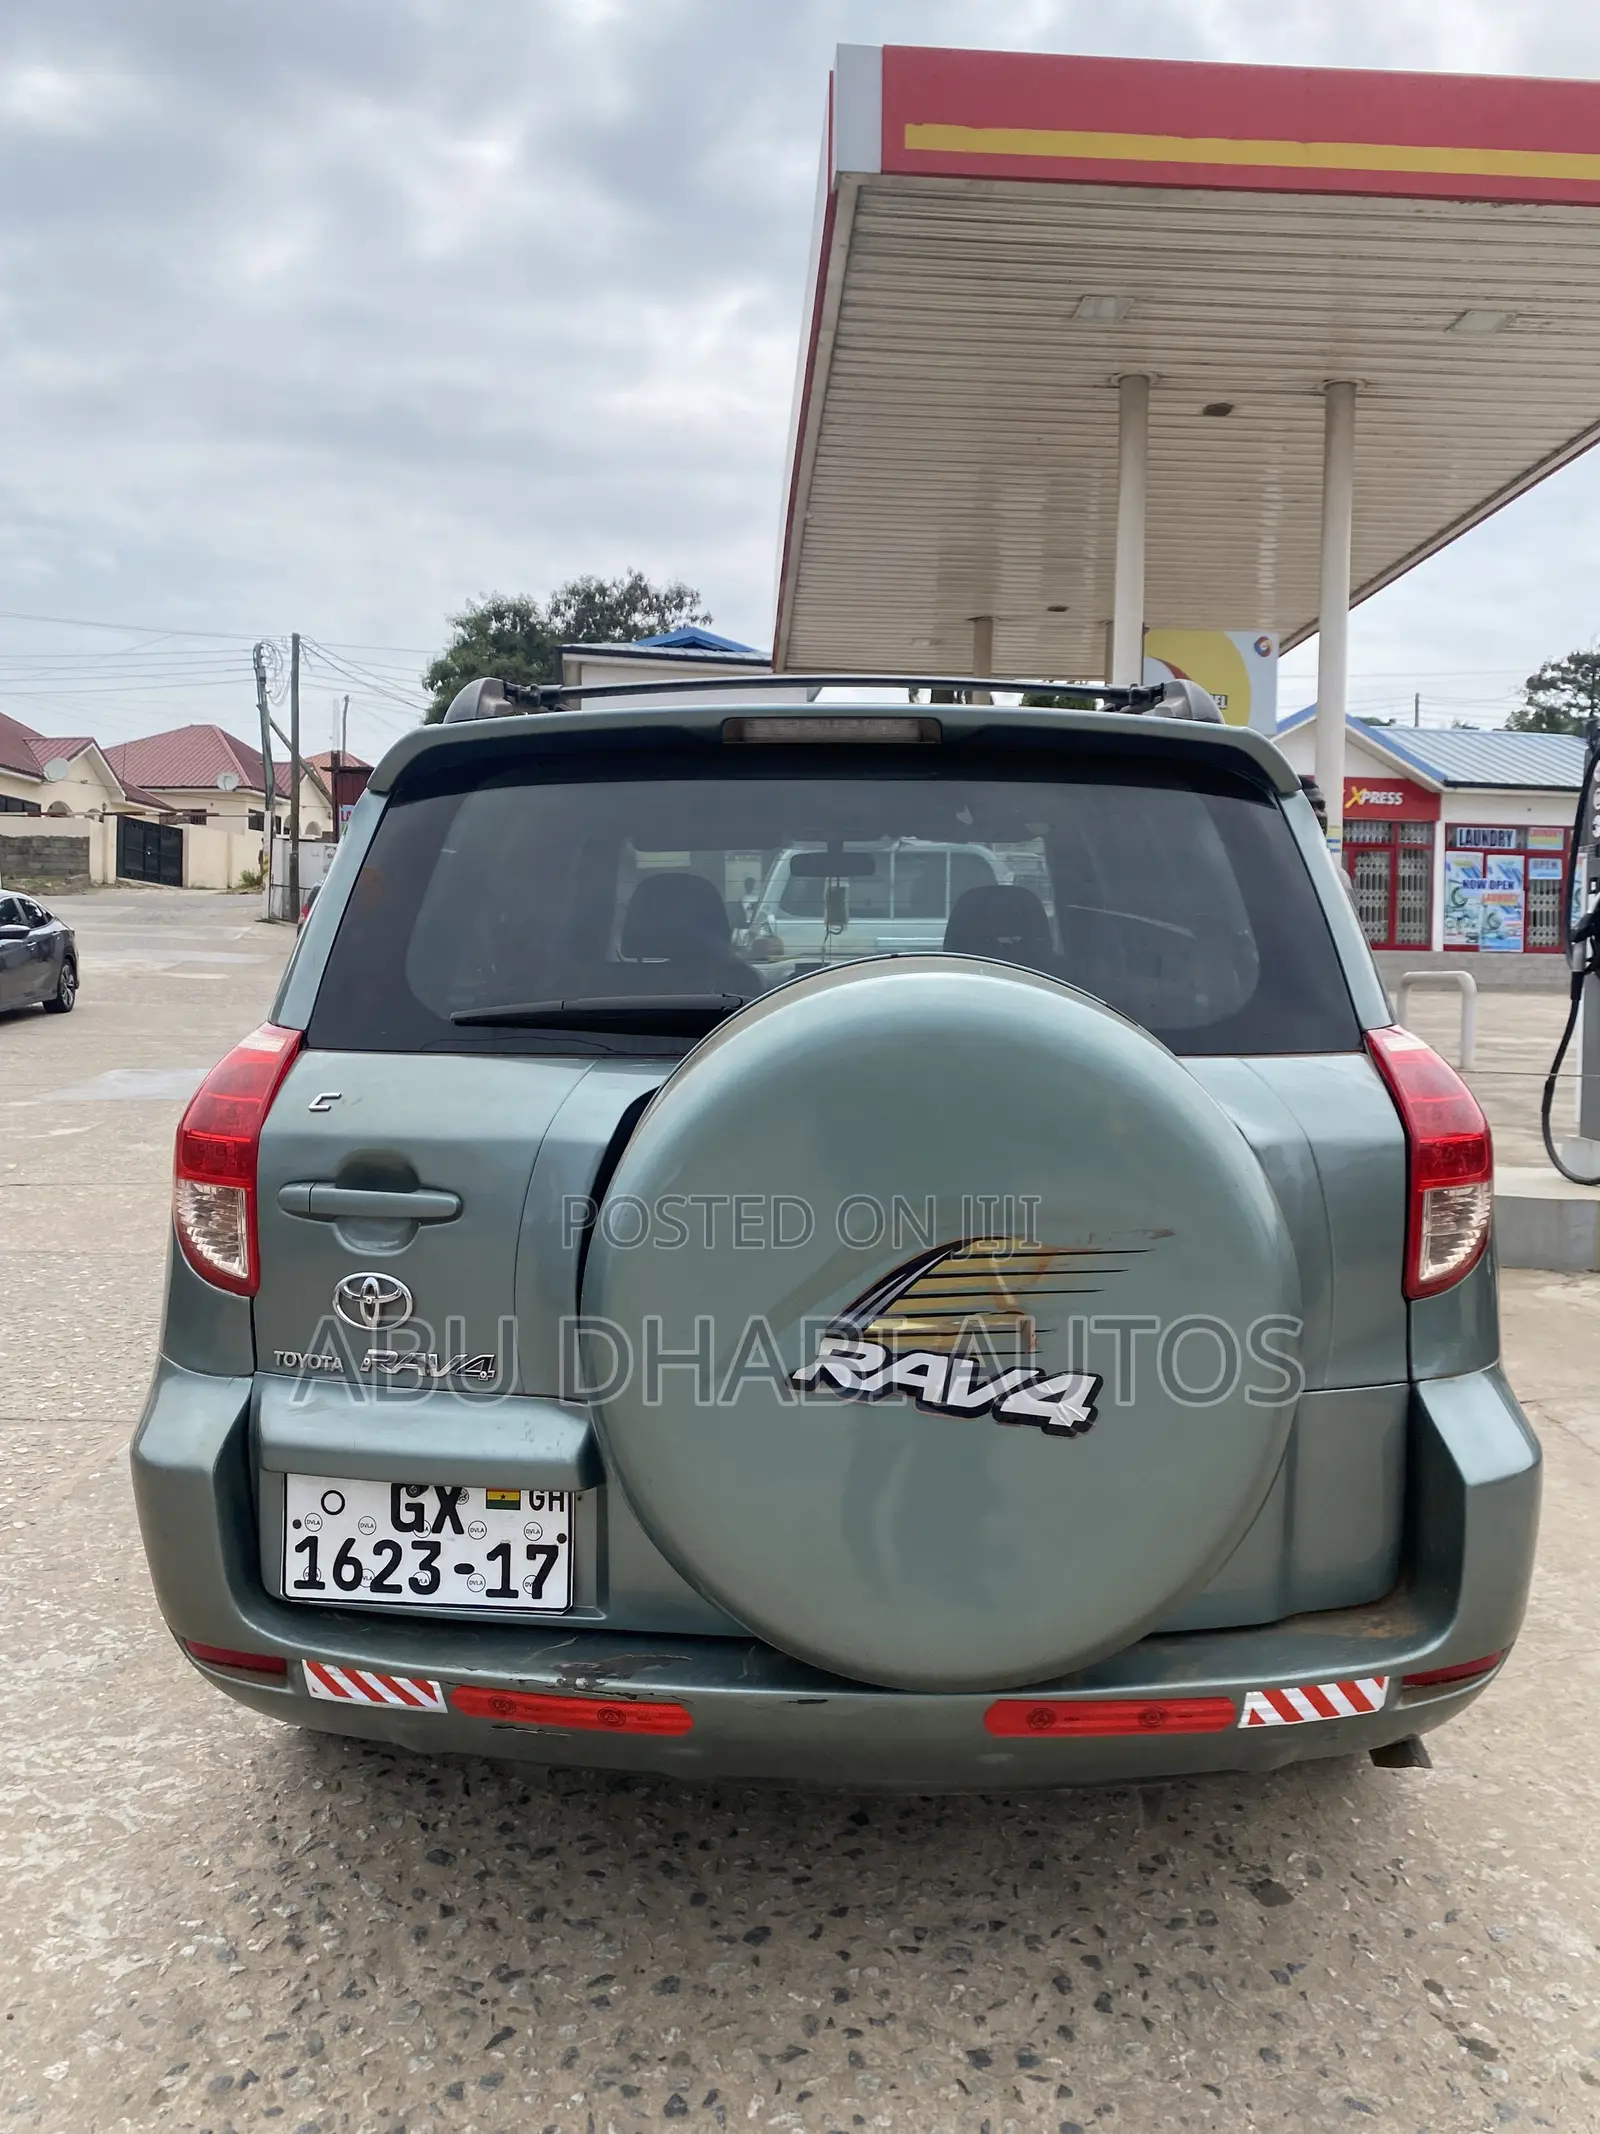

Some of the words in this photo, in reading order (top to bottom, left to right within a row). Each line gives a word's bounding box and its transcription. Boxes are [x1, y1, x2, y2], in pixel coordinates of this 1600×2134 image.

[1345, 786, 1403, 808] XPRESS
[1459, 828, 1514, 848] LAUNDRY
[1462, 879, 1488, 889] NOW
[1489, 880, 1515, 890] OPEN
[273, 1350, 344, 1374] TOYOTA
[360, 1348, 496, 1381] RAV4
[790, 1334, 1100, 1431] RAV4
[390, 1483, 465, 1534] GX
[529, 1490, 565, 1512] GH
[293, 1535, 559, 1599] 1623-17
